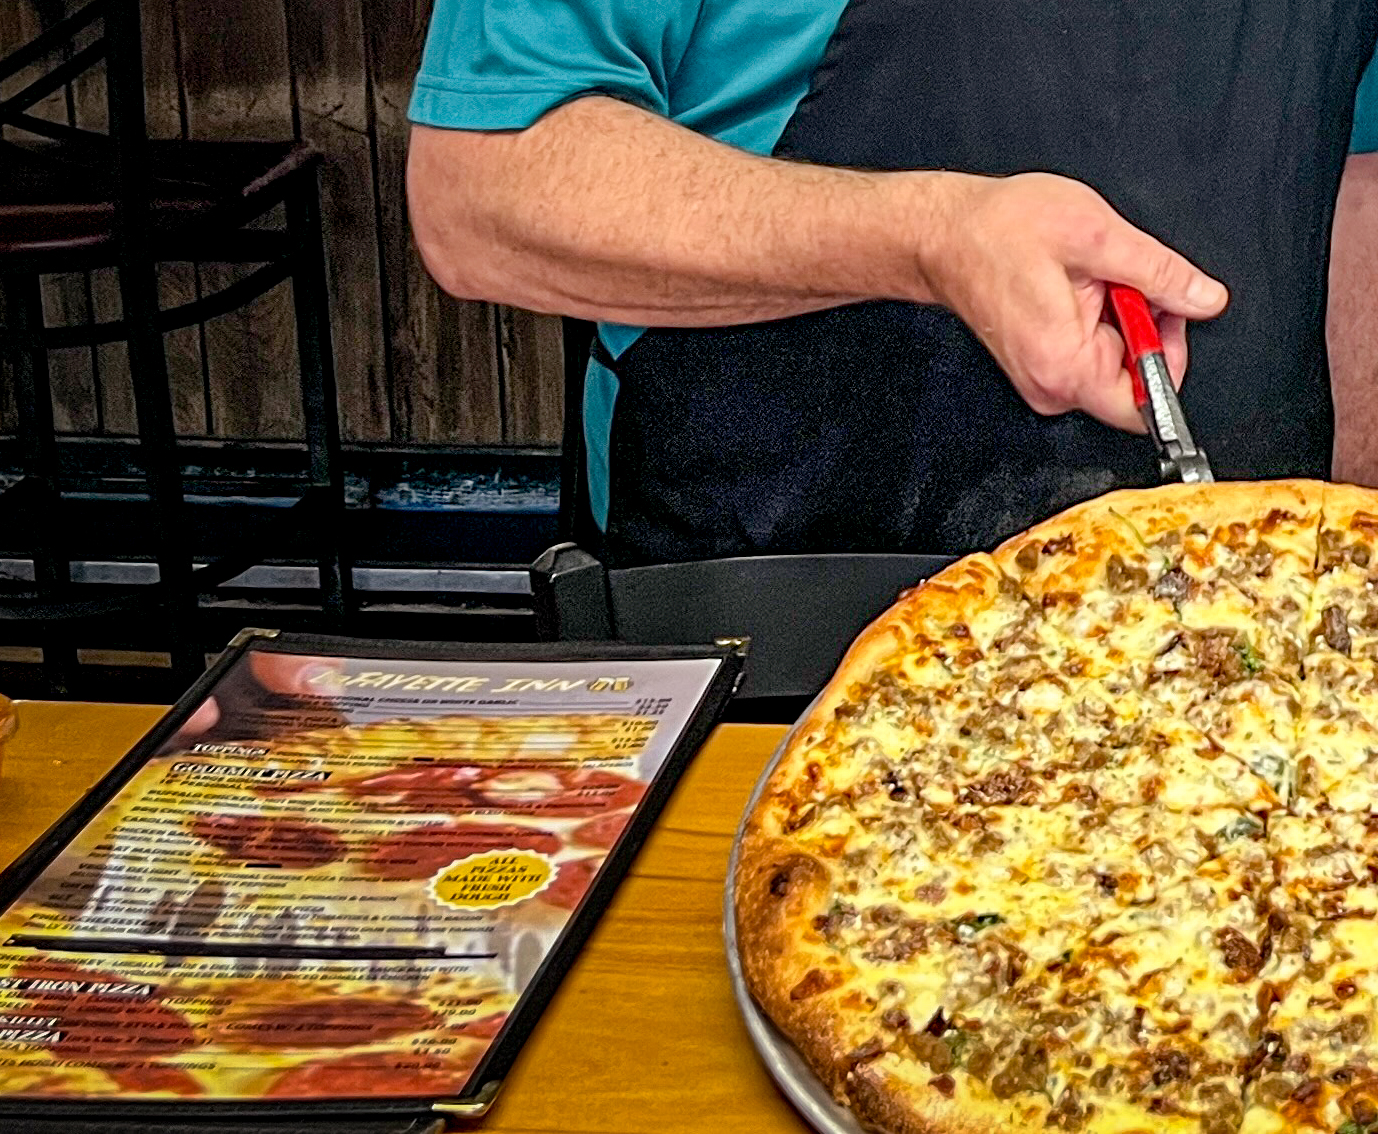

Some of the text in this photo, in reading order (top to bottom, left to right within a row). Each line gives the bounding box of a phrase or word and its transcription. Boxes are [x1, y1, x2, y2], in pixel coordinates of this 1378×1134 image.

[491, 677, 587, 694] INN
[190, 742, 269, 756] TOPPINGS
[270, 768, 327, 782] PIZZA
[490, 856, 518, 864] ALL
[497, 873, 543, 882] WITH
[28, 979, 152, 996] IRON PIZZA
